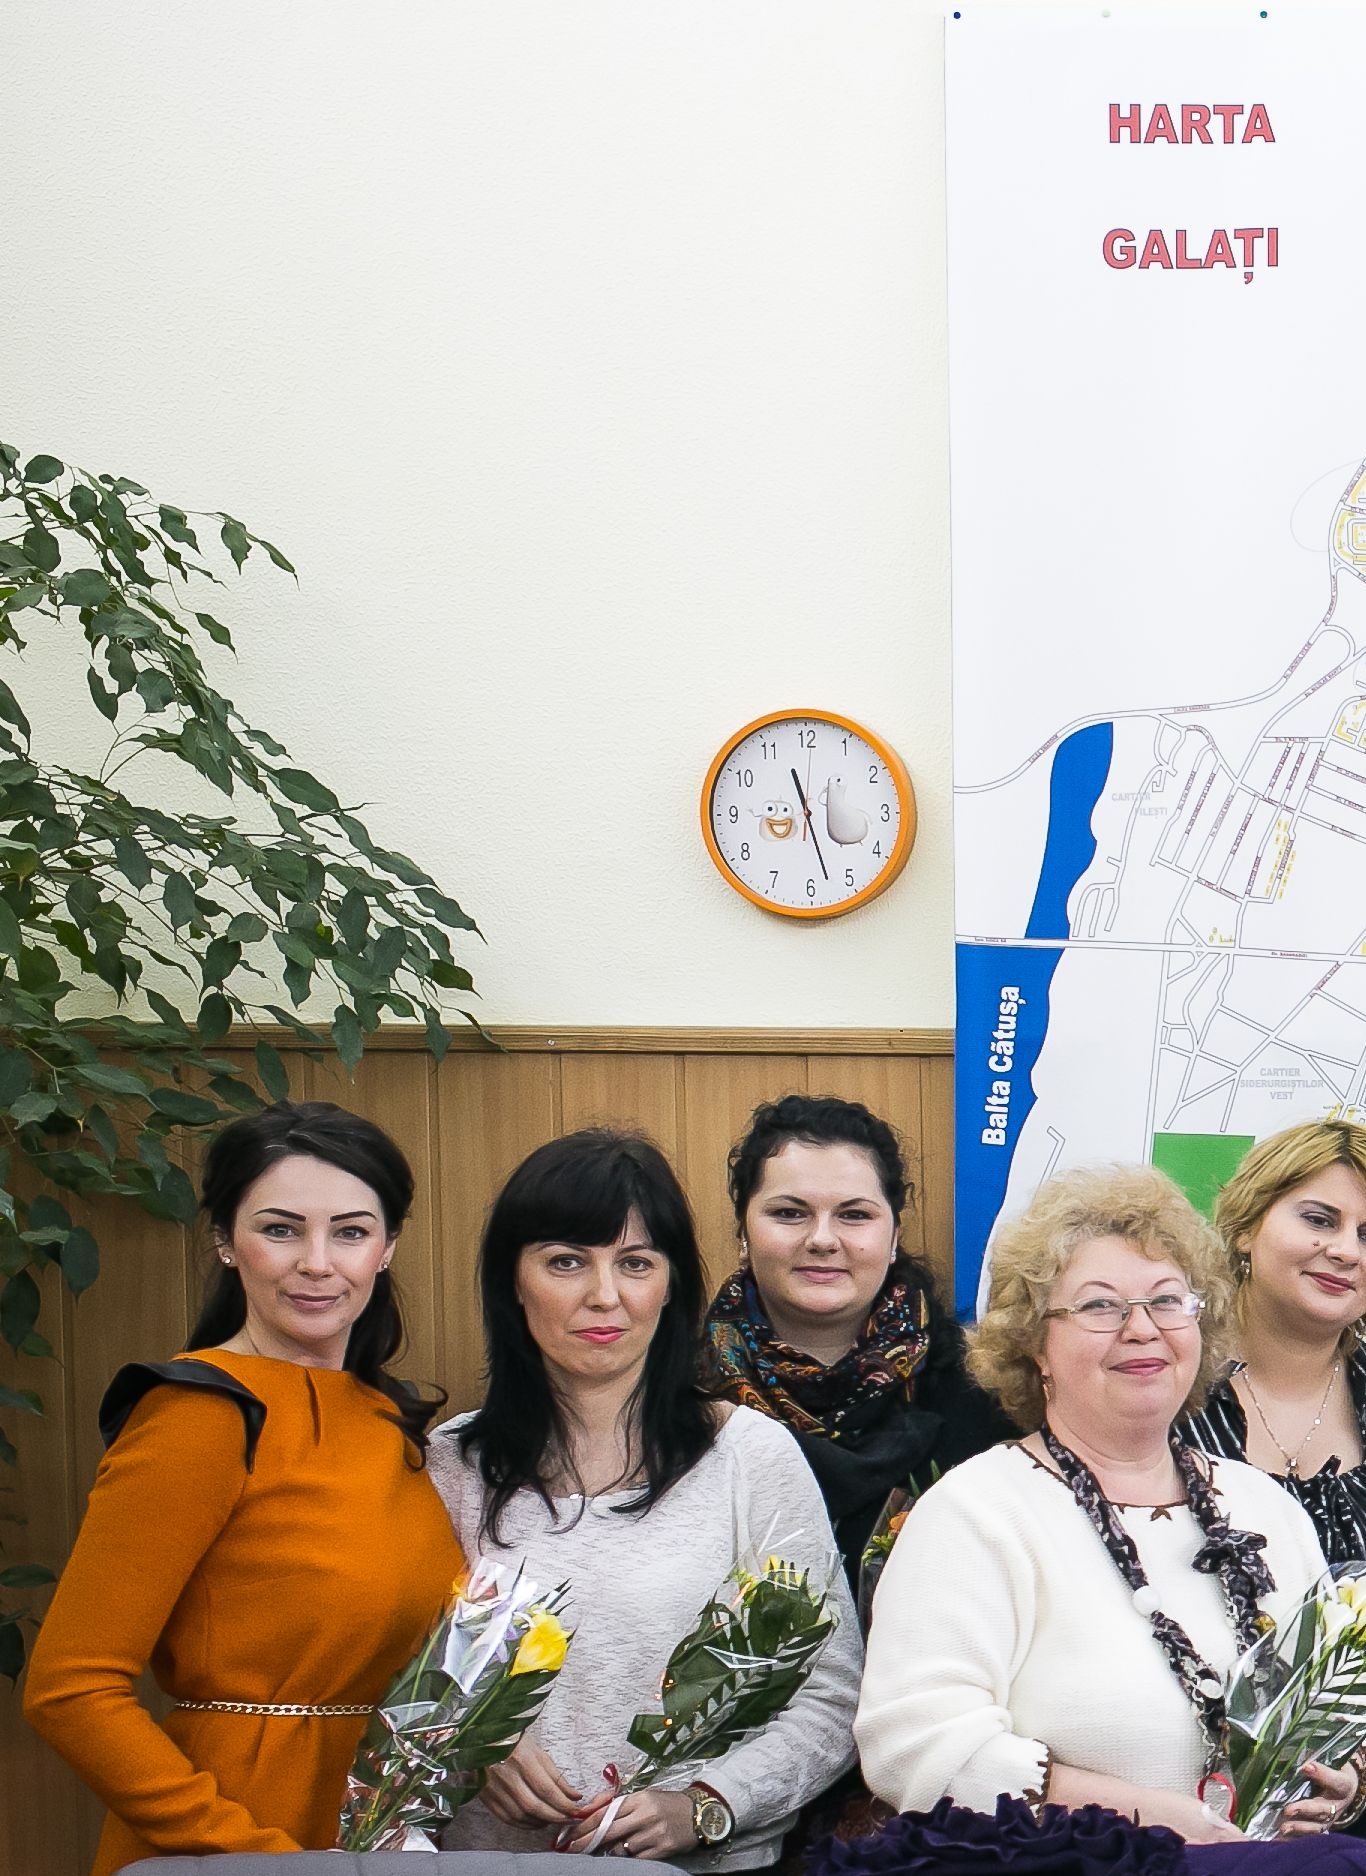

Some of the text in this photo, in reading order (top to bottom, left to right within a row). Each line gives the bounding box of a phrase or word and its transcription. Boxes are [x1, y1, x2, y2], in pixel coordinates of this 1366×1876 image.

[1109, 103, 1275, 144] HARTA
[1103, 228, 1278, 284] GALAȚI
[798, 729, 816, 748] 12
[841, 738, 848, 756] 1
[761, 742, 777, 760] 11
[736, 769, 753, 788] 10
[868, 765, 878, 784] 2
[729, 805, 738, 824] 9
[880, 803, 890, 822] 3
[740, 842, 750, 861] 8
[872, 840, 882, 858] 4
[769, 870, 779, 889] 7
[845, 868, 855, 887] 5
[806, 878, 816, 897] 6
[1260, 1067, 1301, 1077] CARTIER
[1270, 1091, 1294, 1100] VEST
[982, 1080, 1011, 1146] Balta
